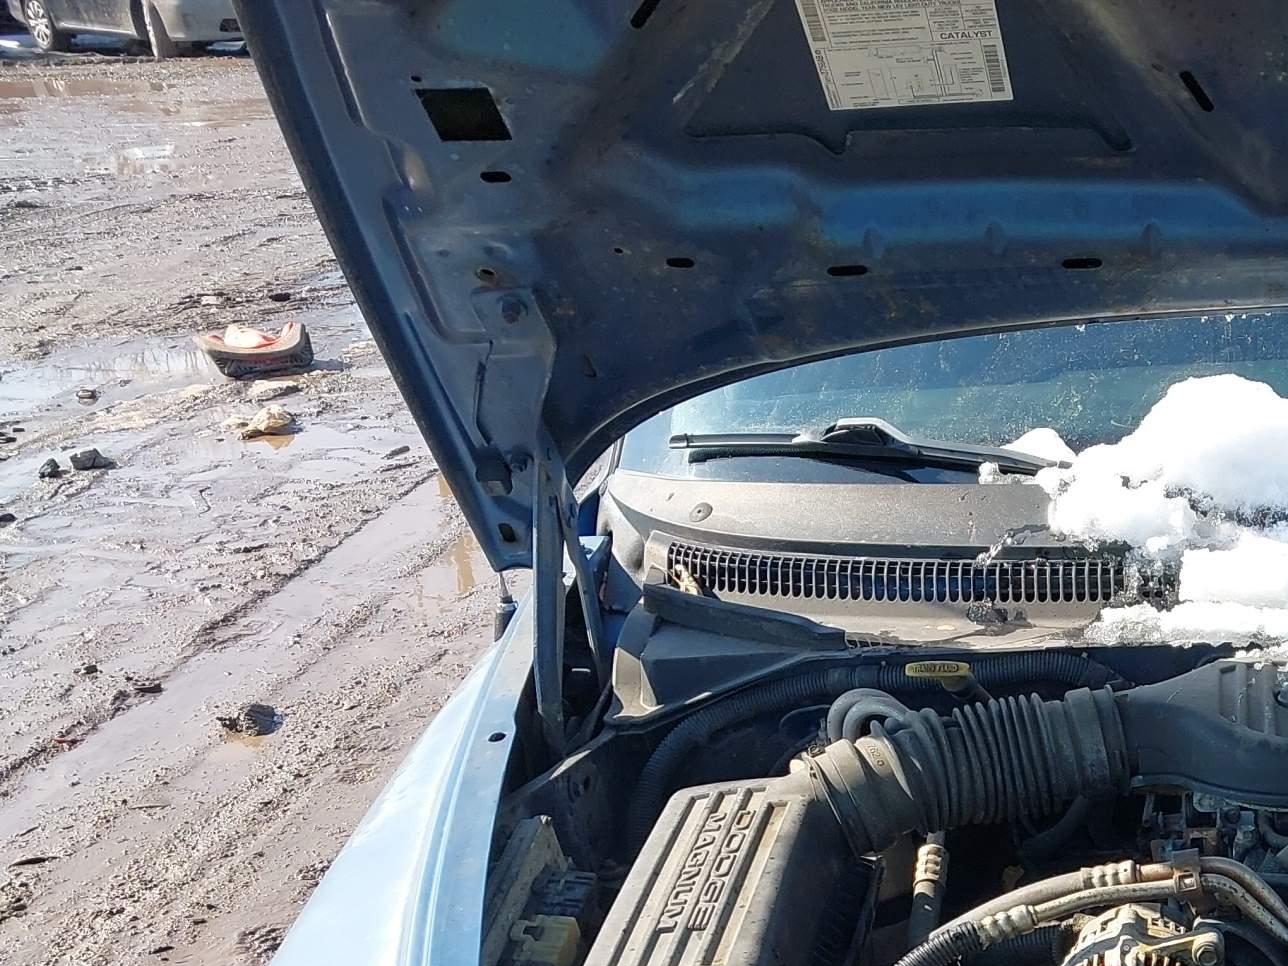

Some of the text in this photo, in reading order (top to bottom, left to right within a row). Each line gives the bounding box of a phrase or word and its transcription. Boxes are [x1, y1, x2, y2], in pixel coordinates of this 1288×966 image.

[940, 30, 993, 40] CATALYST
[656, 812, 728, 933] MAGNUM
[687, 809, 757, 931] DODGE
